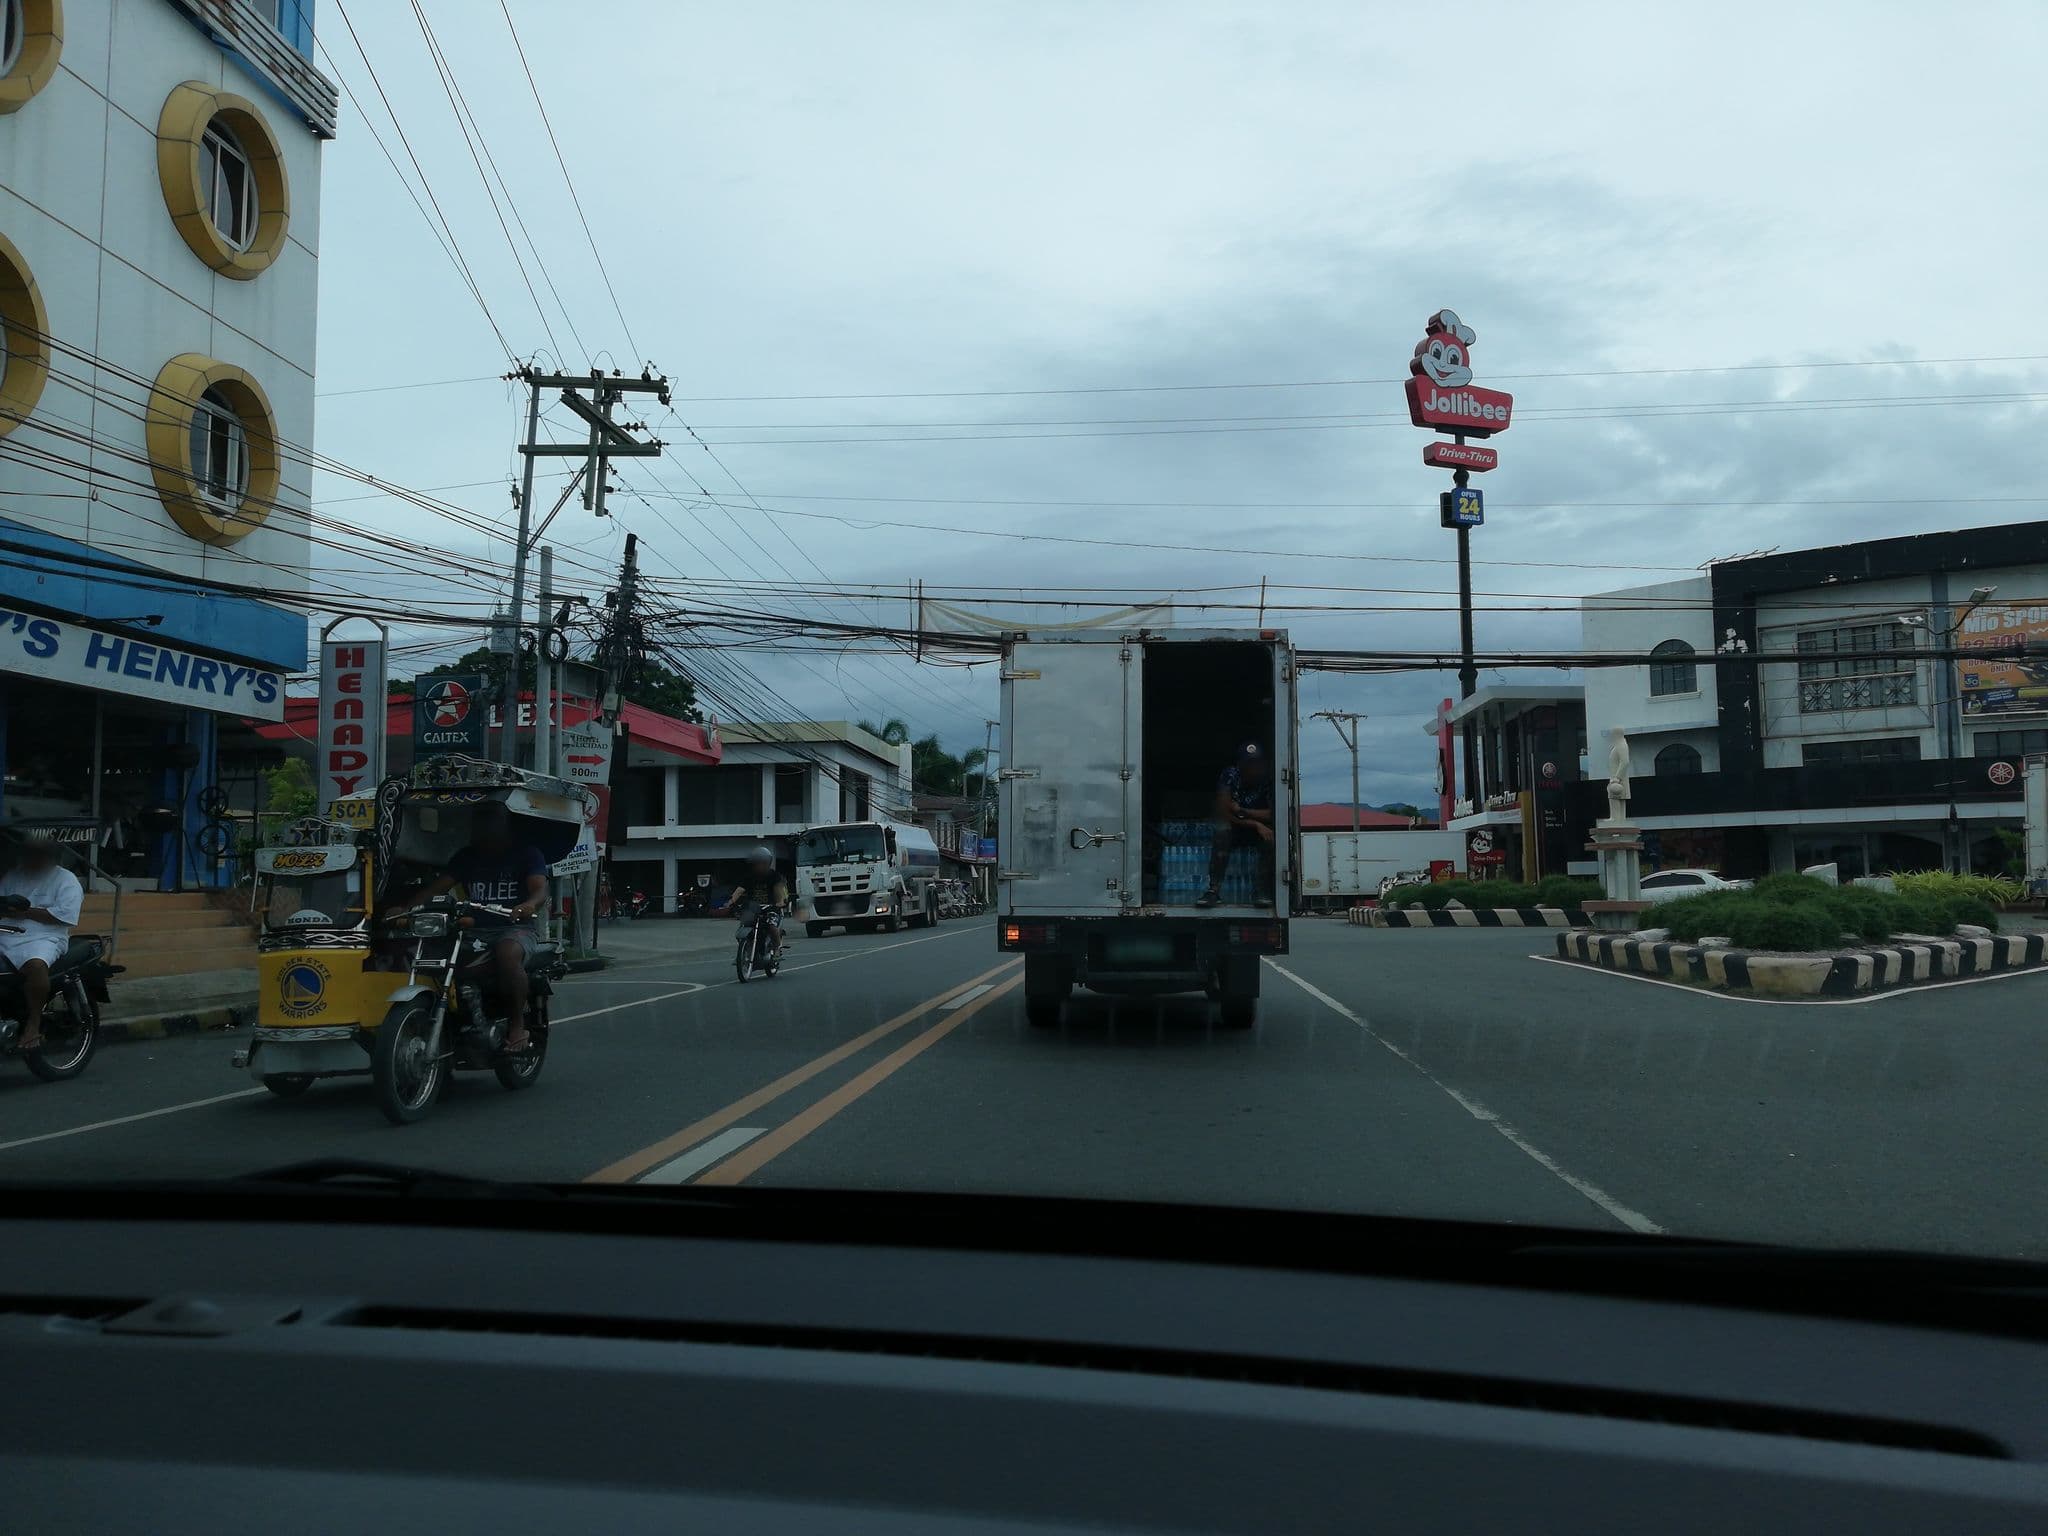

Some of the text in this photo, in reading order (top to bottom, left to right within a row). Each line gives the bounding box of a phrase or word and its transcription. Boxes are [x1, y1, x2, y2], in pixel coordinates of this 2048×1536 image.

[1424, 389, 1508, 421] Jollibee
[1440, 447, 1494, 463] Drive-Thru
[1459, 497, 1480, 515] 24
[1460, 514, 1481, 522] HOURS
[84, 632, 279, 704] HENRY'S
[423, 731, 469, 745] CALTEX
[571, 767, 599, 778] 900m
[287, 916, 330, 925] HONDA
[306, 956, 332, 981] STATE
[279, 1001, 327, 1019] WARRIORS
